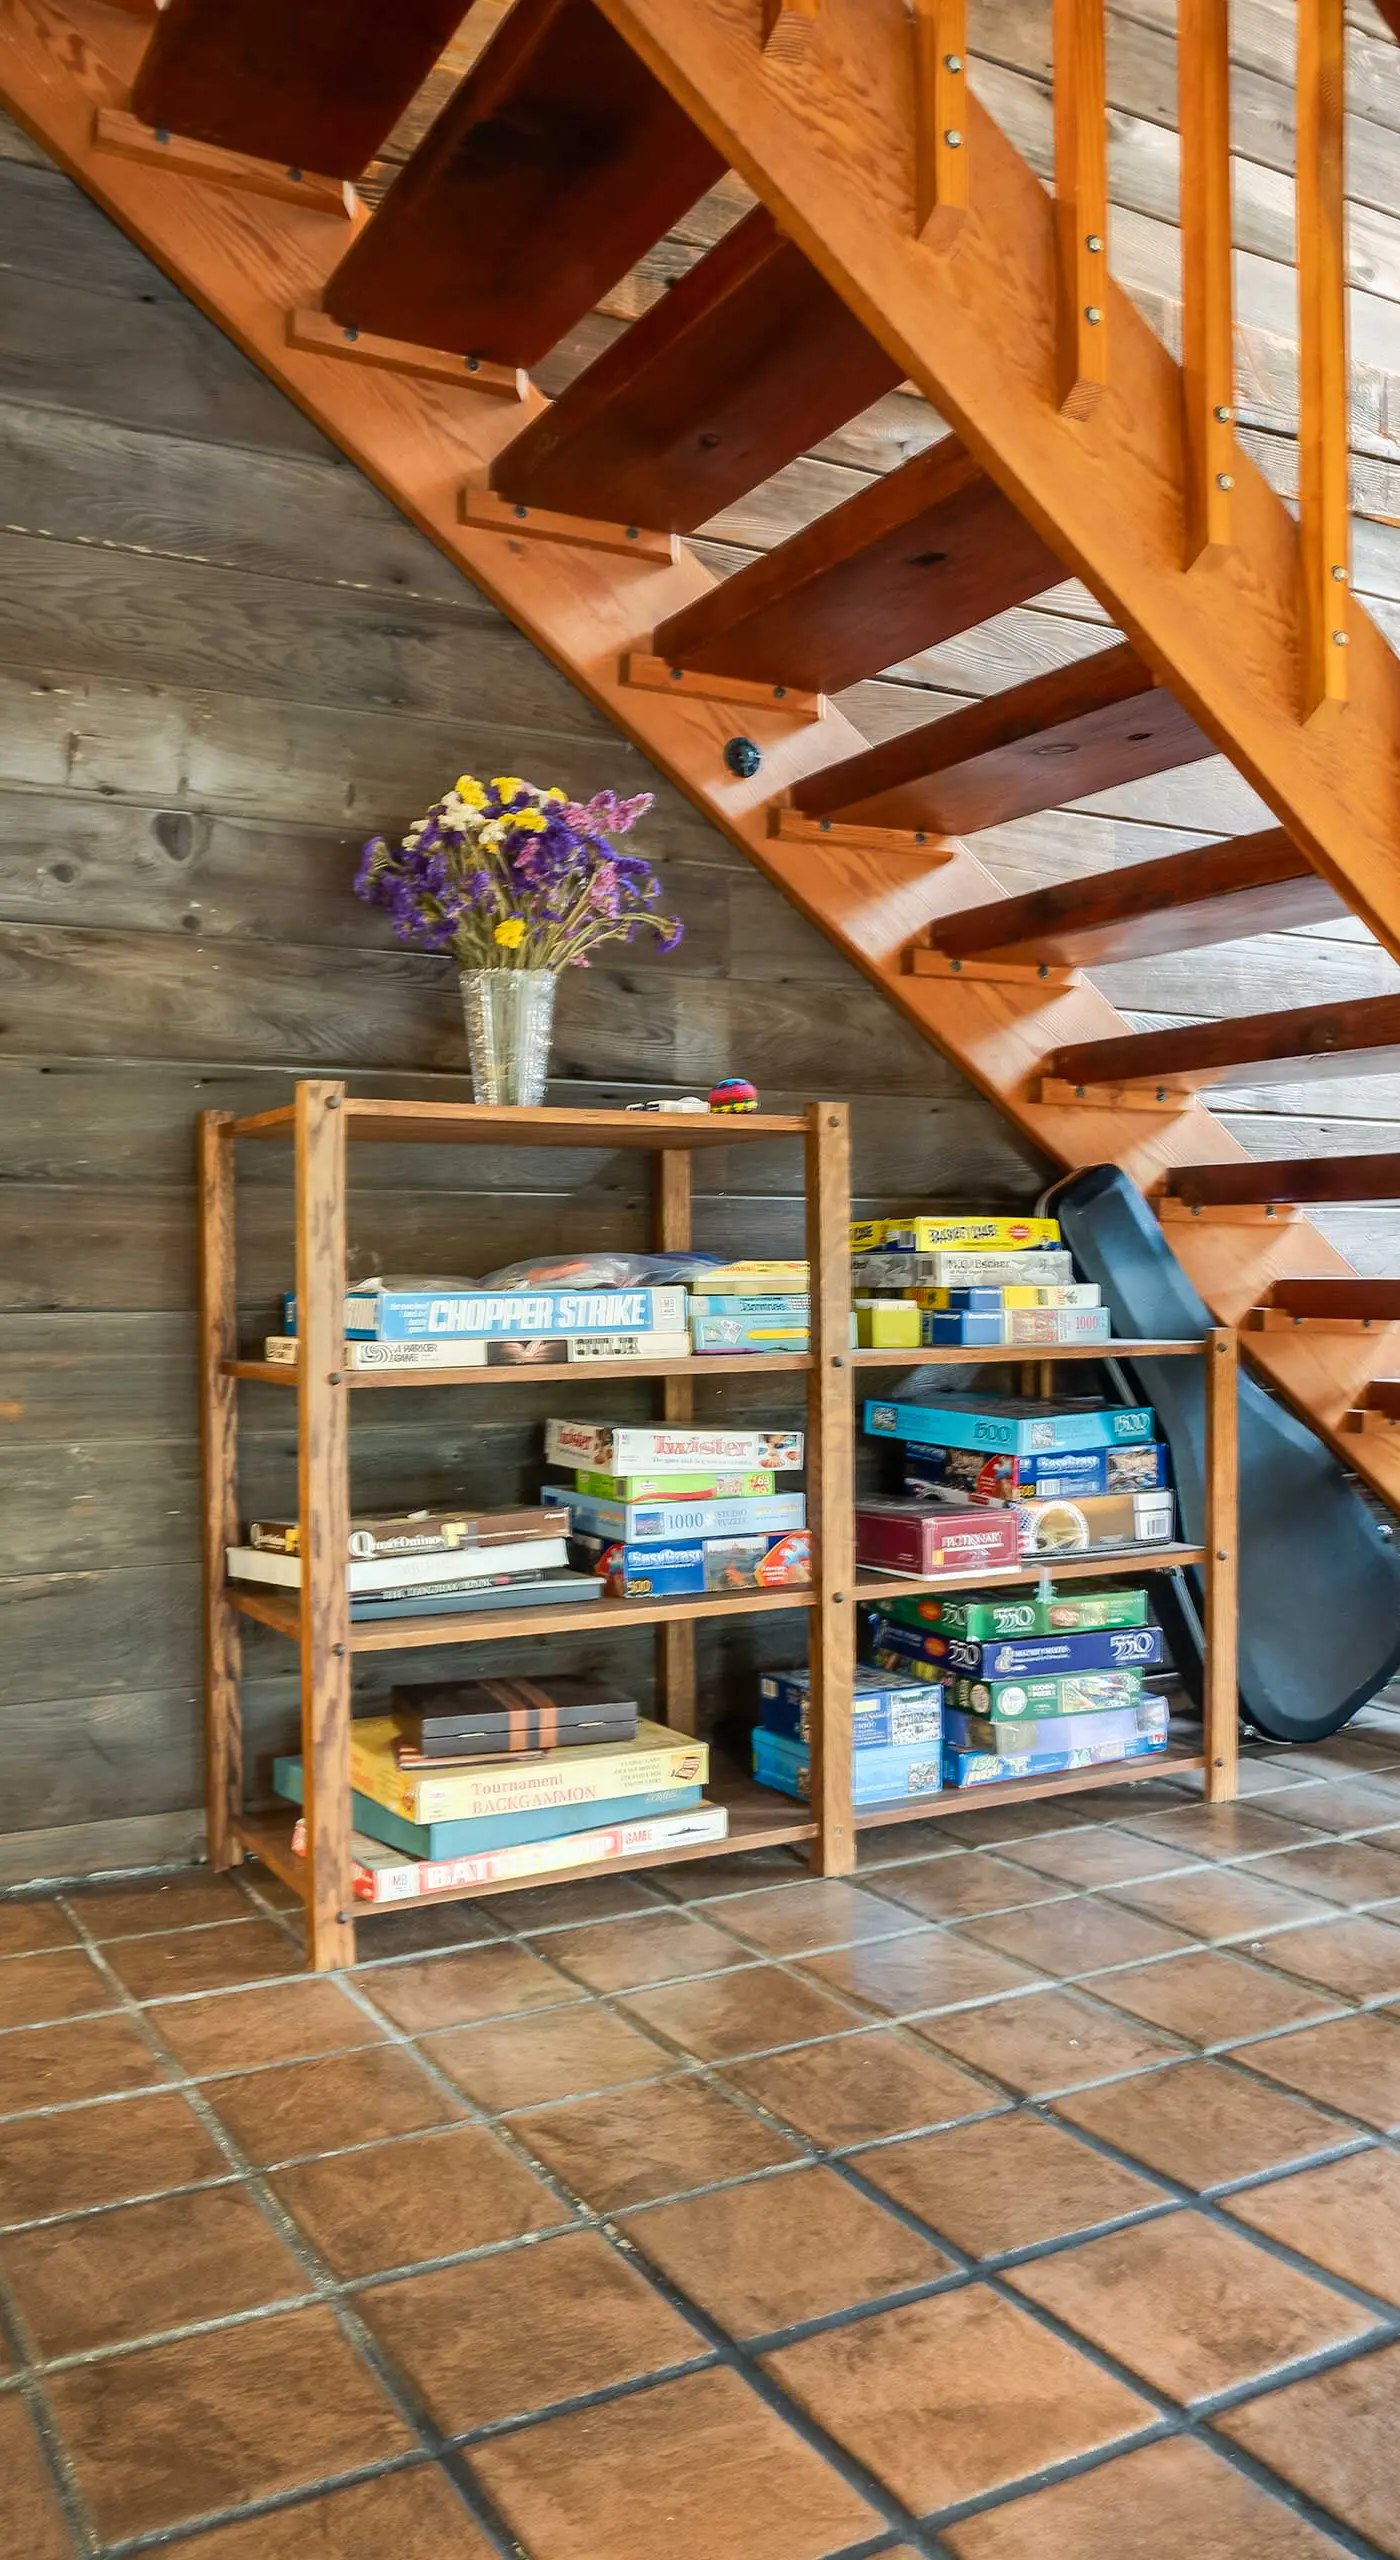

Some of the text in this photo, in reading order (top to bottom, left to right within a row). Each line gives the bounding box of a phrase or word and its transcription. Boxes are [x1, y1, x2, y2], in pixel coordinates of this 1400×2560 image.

[974, 1258, 1010, 1269] Escher
[428, 1297, 553, 1333] CHOPPER
[557, 1294, 646, 1327] STRIKE
[1075, 1315, 1098, 1329] 1000
[653, 1435, 752, 1456] Twister
[668, 1512, 704, 1529] 1000
[471, 1774, 563, 1796] Tournament
[472, 1786, 597, 1815] BACKGAMMON
[624, 1829, 652, 1843] GAME
